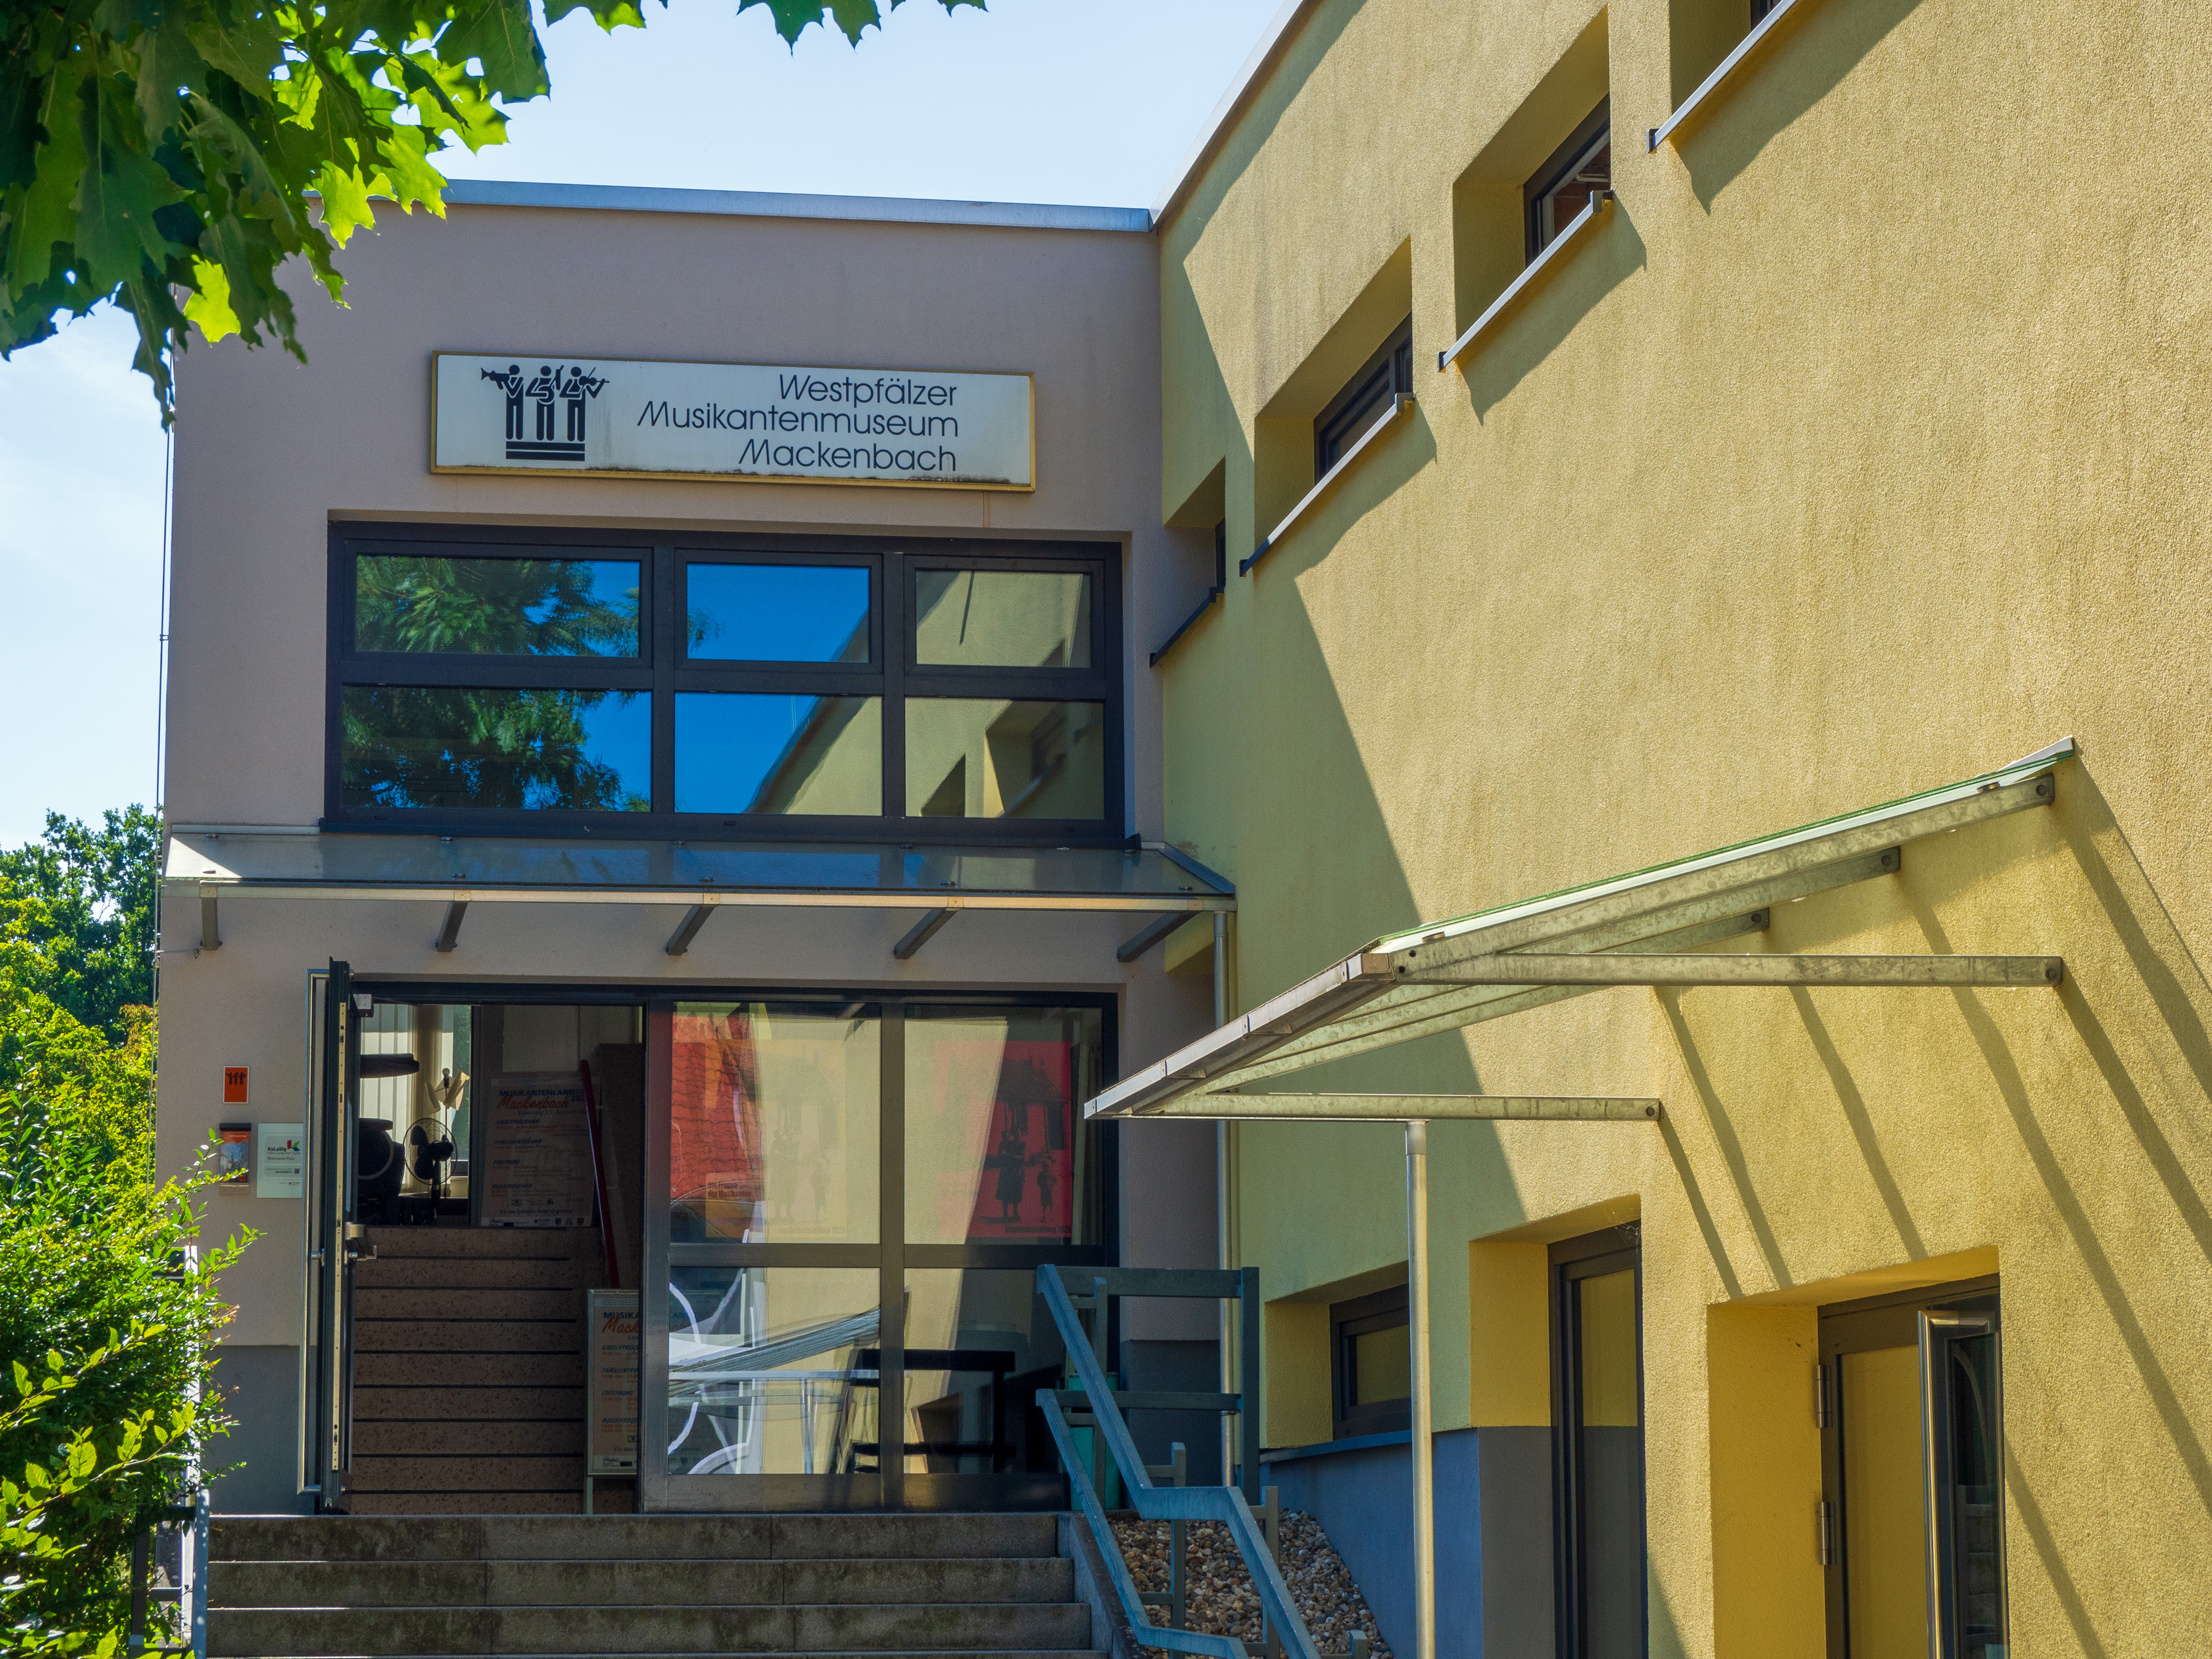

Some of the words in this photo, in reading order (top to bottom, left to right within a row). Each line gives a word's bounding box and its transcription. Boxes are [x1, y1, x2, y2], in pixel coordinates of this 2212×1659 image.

[780, 374, 958, 408] Westpfälzer
[637, 401, 958, 437] Musikantenmuseum
[738, 438, 956, 471] Mackenbach
[496, 1095, 570, 1109] Mackenbach
